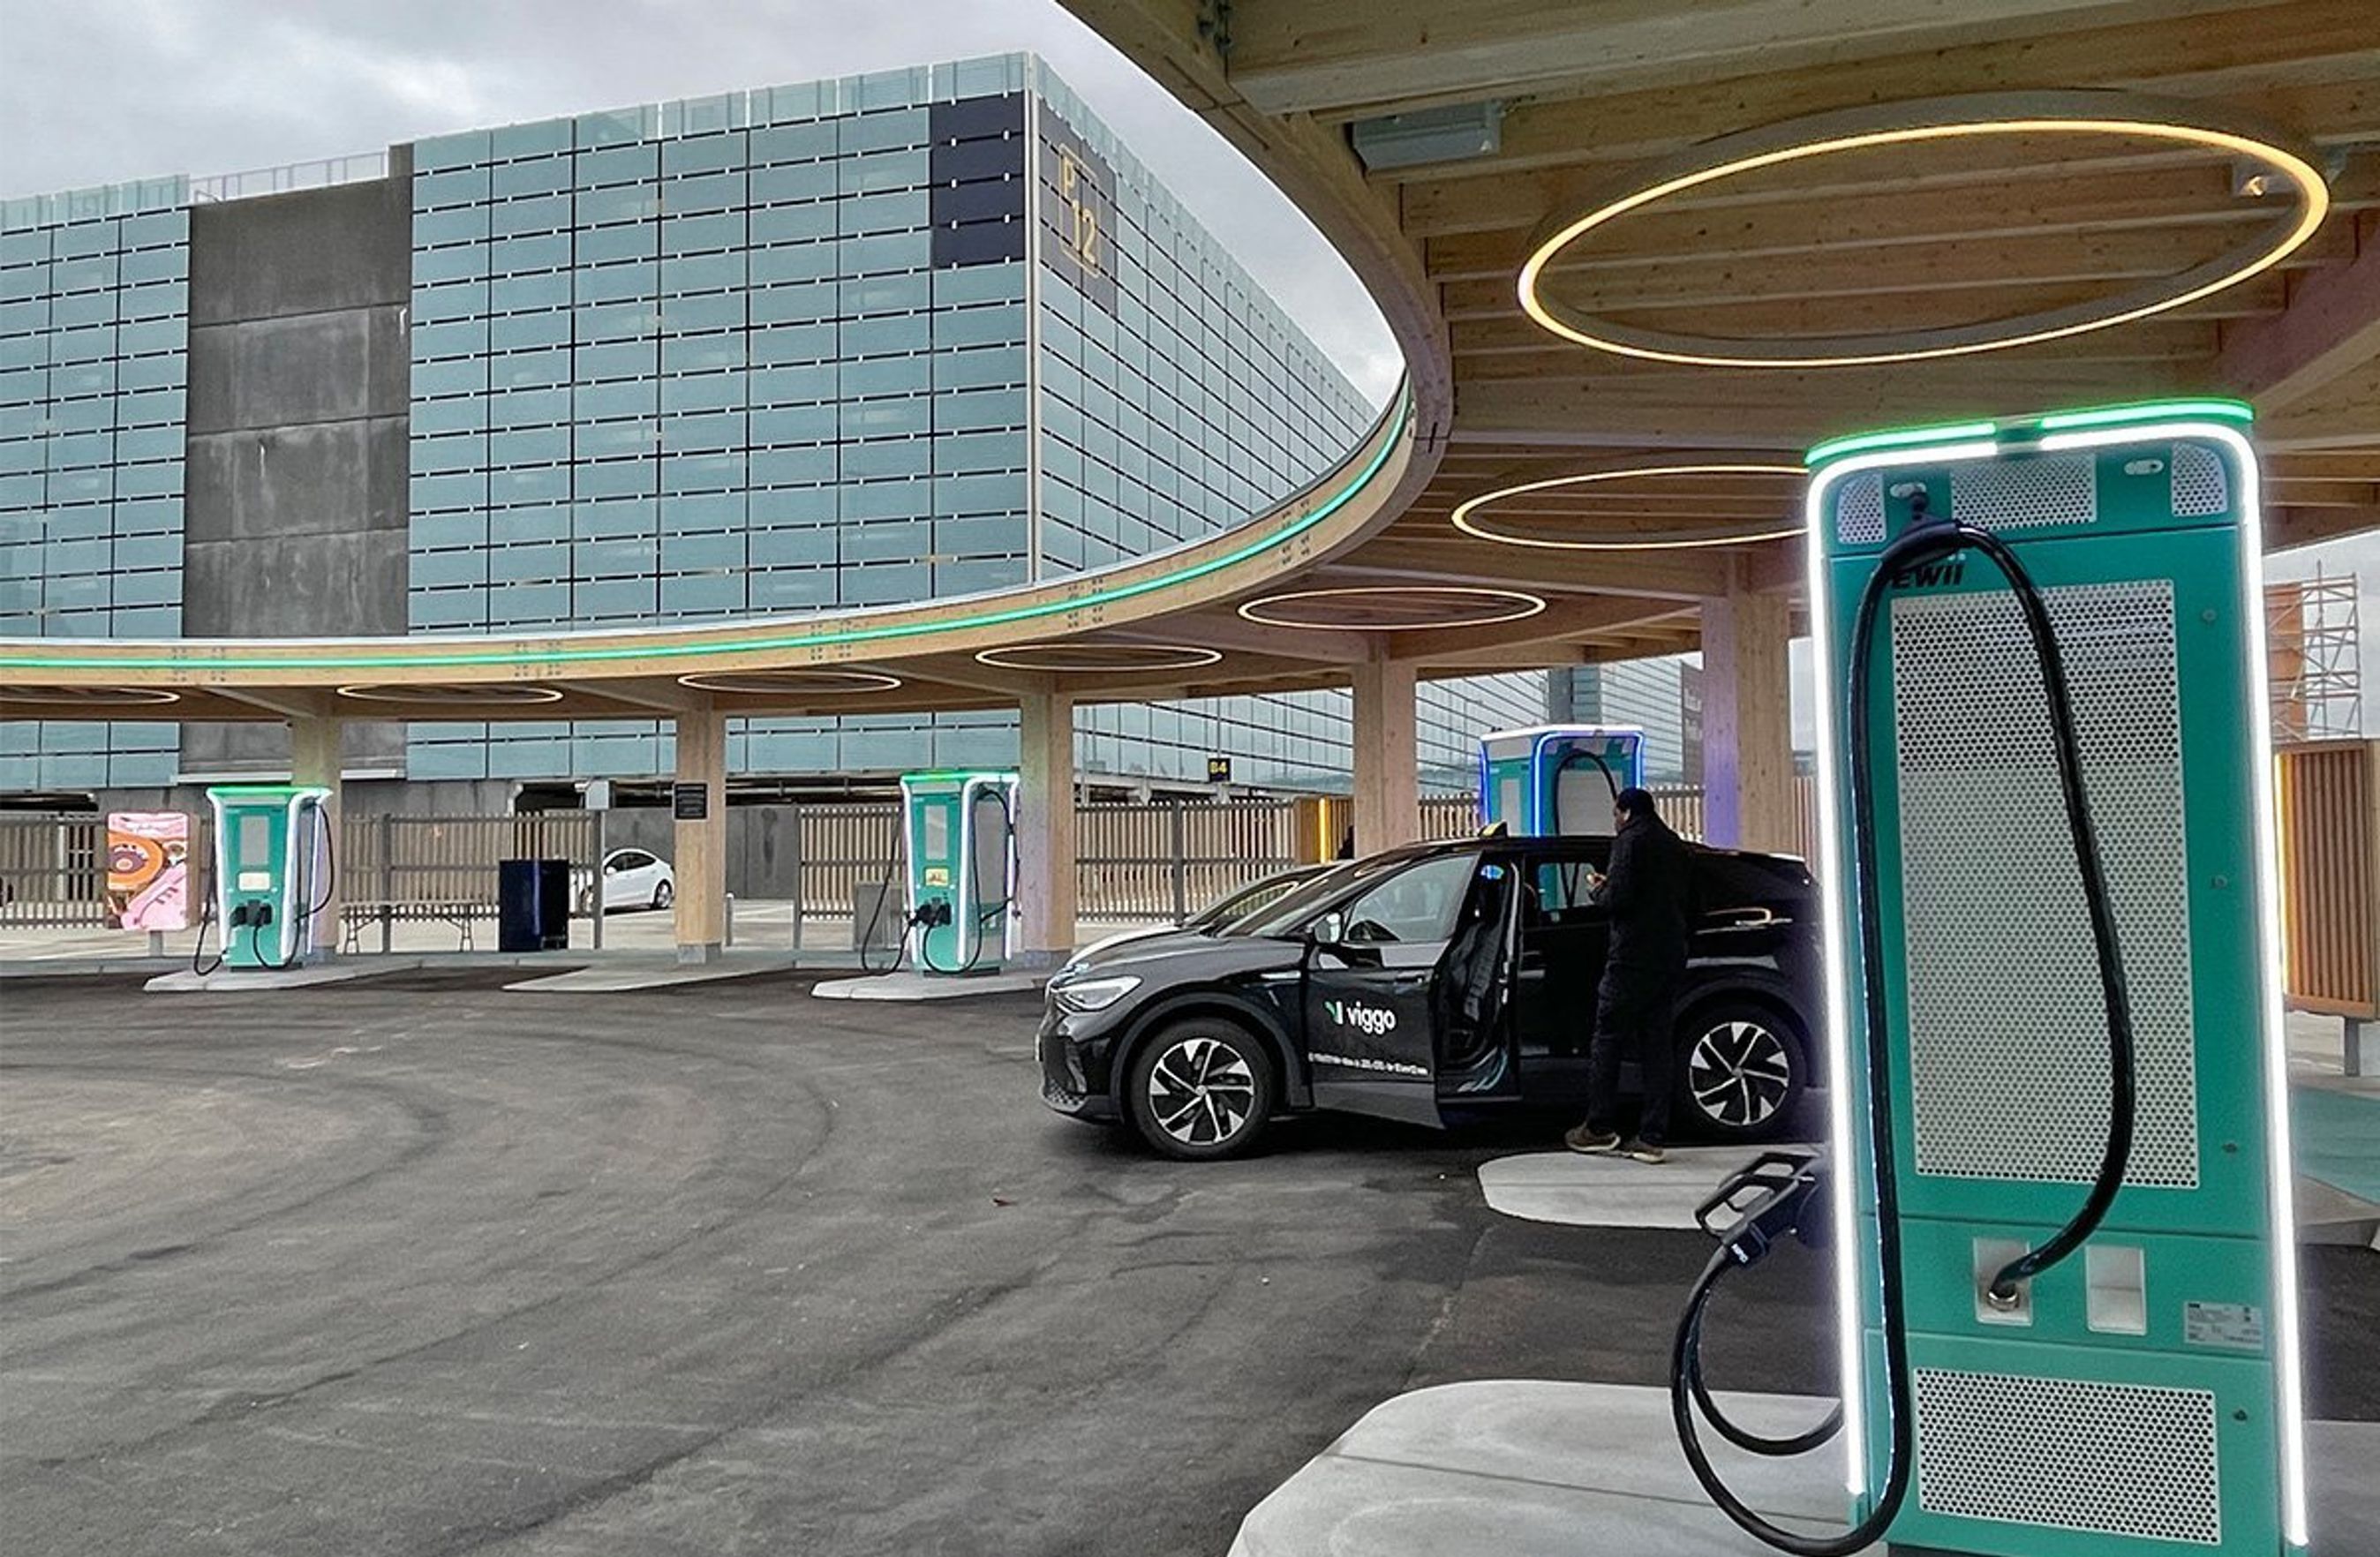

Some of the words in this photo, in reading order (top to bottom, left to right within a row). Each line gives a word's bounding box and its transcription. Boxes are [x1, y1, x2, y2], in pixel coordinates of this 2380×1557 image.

[1062, 155, 1076, 198] P
[1072, 199, 1096, 264] 12
[1346, 1001, 1397, 1034] viggo
